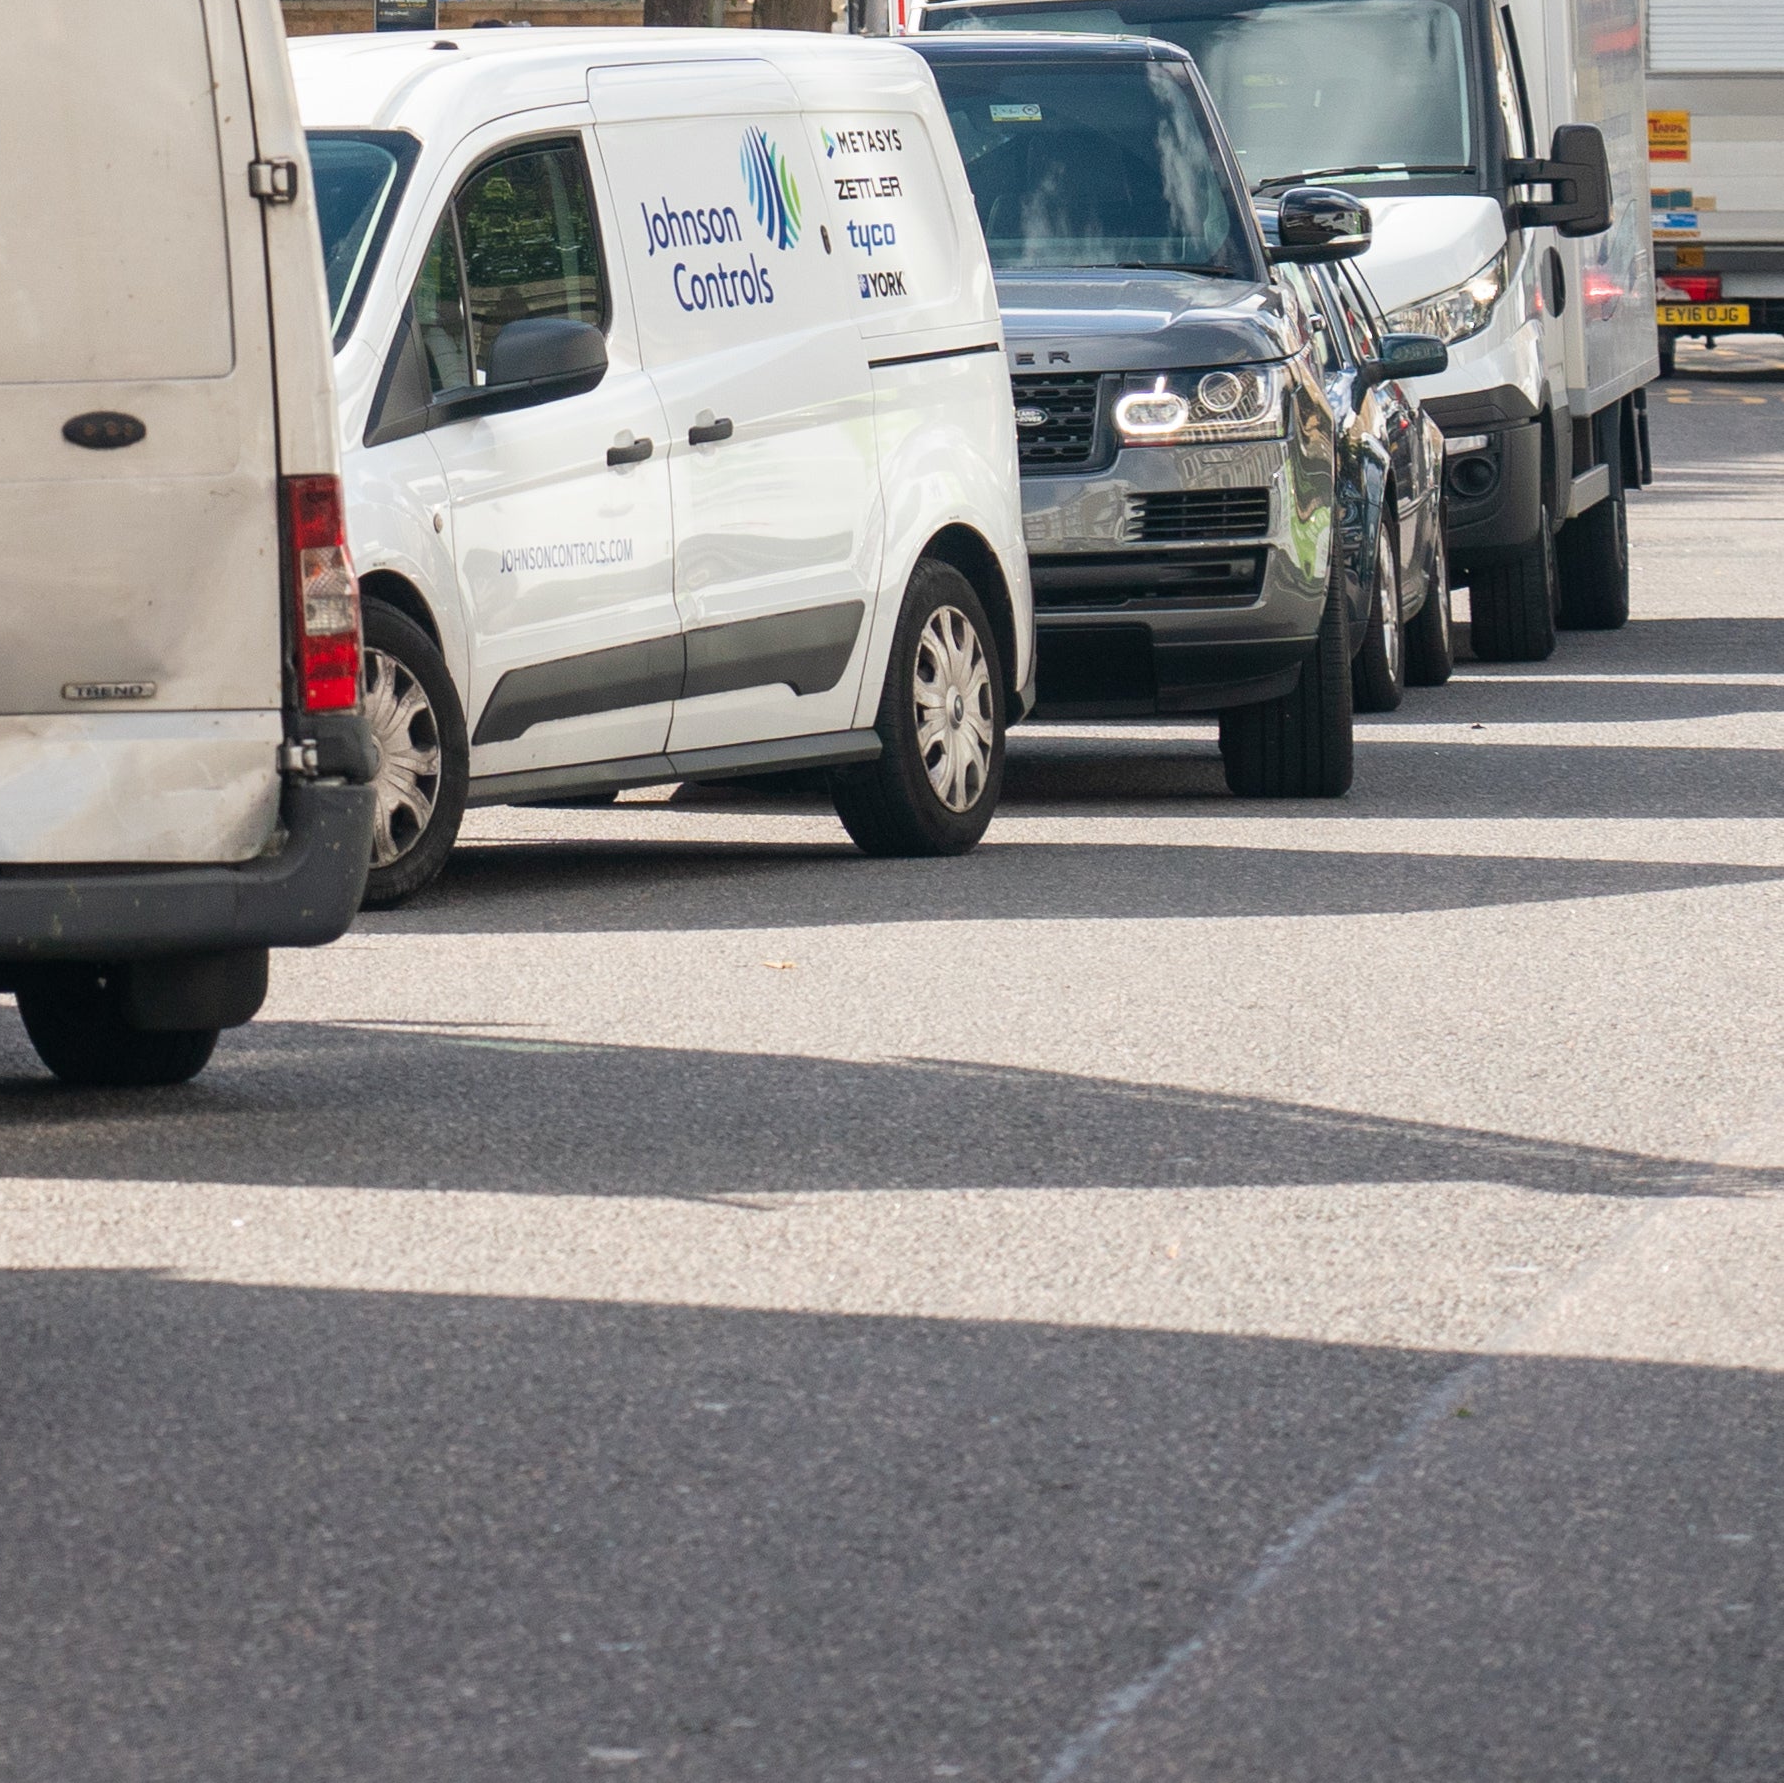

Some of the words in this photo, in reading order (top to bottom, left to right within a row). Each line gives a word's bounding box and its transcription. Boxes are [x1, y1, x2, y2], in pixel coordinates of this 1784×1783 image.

[836, 129, 903, 154] METASYS
[834, 176, 903, 200] ZETTLER
[640, 195, 742, 257] Johnson
[846, 219, 897, 256] tyco
[673, 252, 775, 312] Controls
[870, 271, 907, 298] YORK
[1665, 307, 1702, 322] EY16
[500, 538, 634, 573] JOHNSONCONTROLS.COM
[77, 684, 144, 698] TREND
